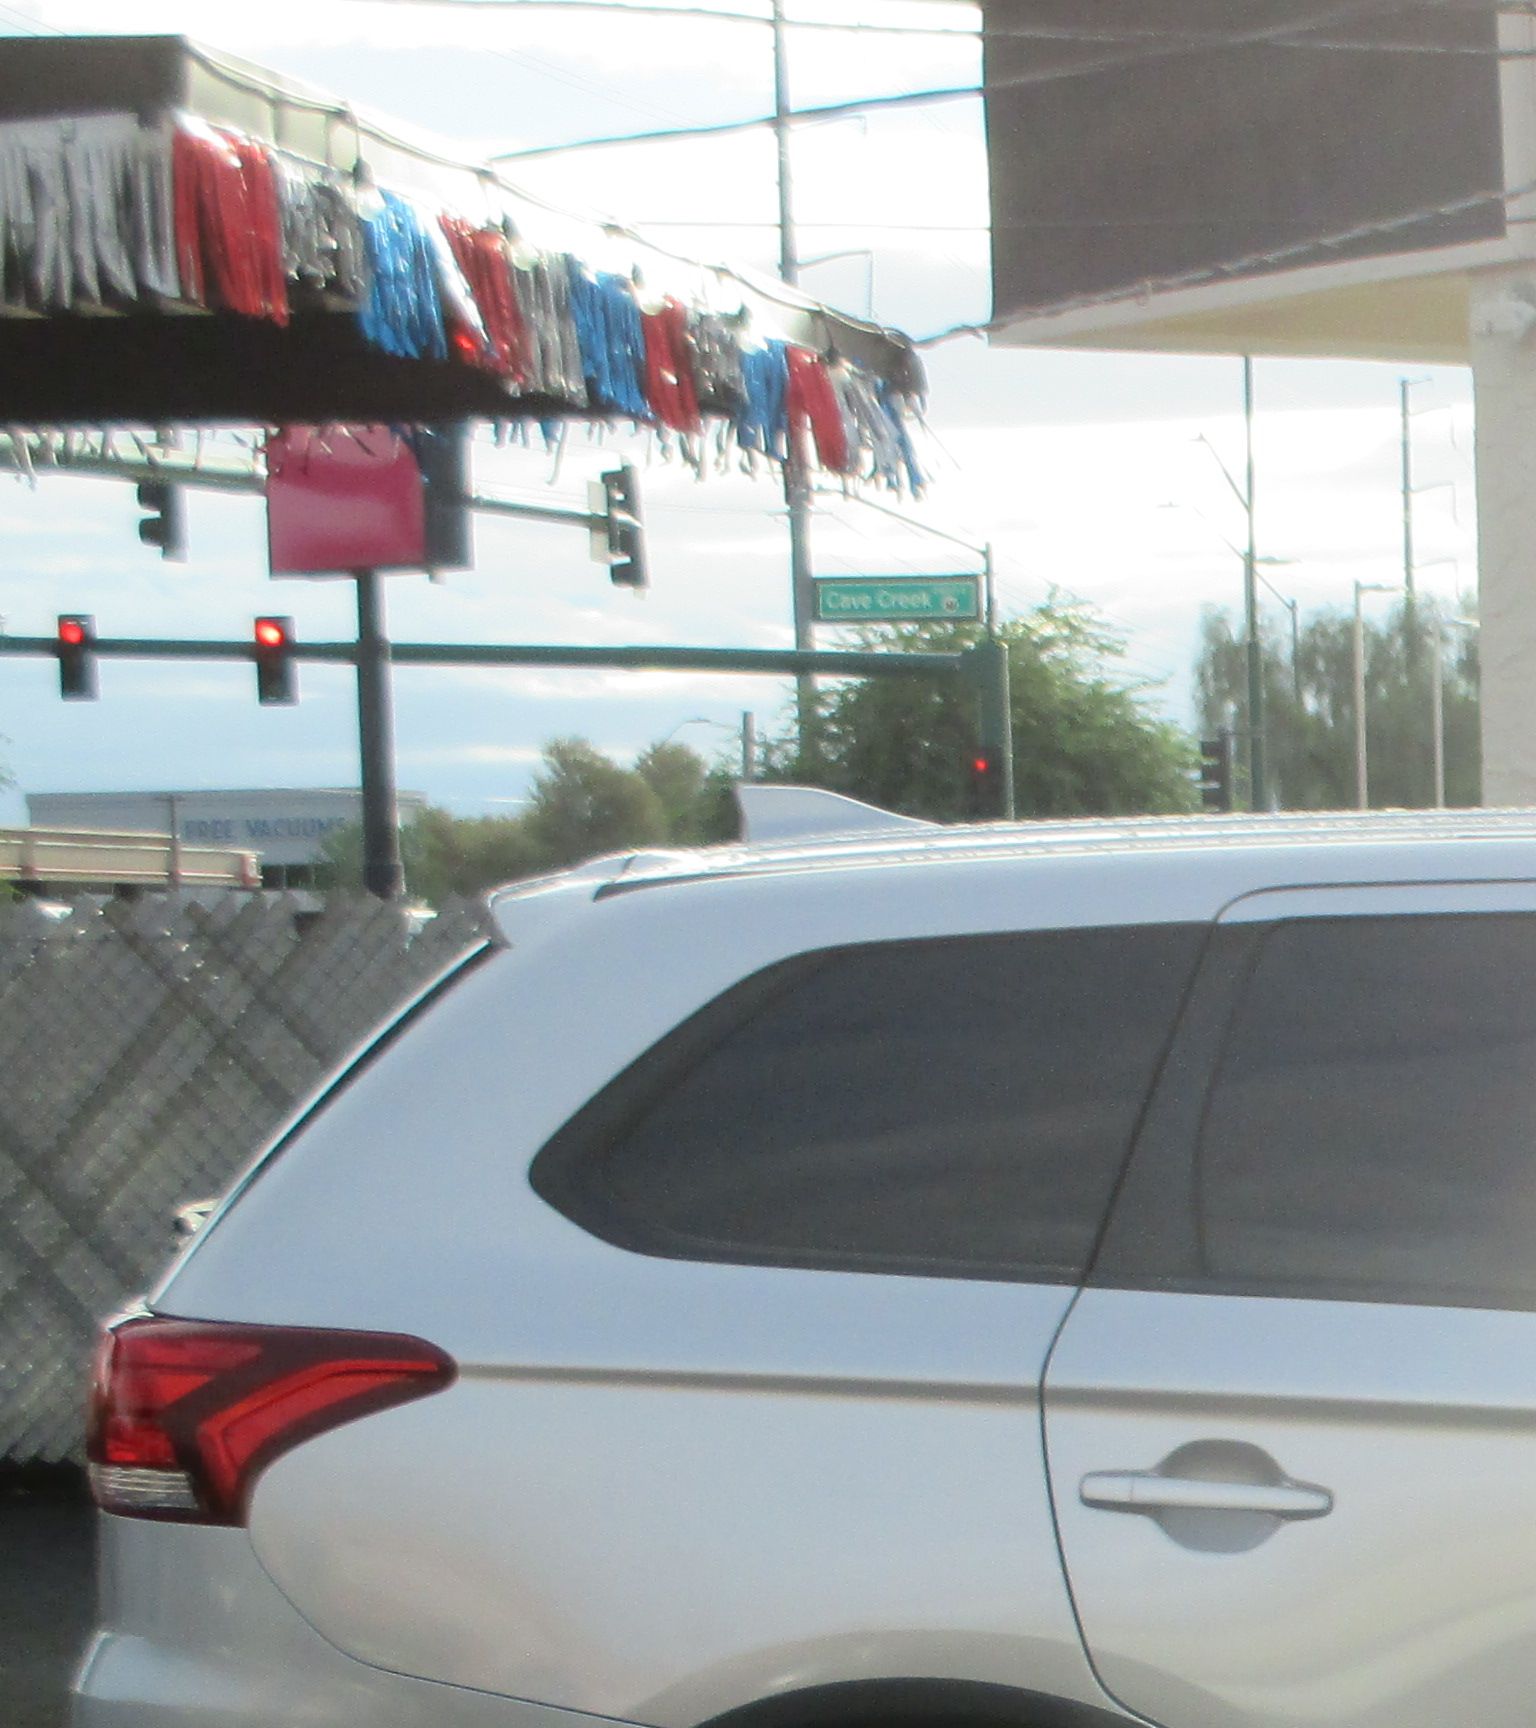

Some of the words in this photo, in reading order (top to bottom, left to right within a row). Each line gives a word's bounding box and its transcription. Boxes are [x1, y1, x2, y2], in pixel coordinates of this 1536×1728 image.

[827, 592, 872, 609] Cave
[877, 590, 932, 609] Creek
[184, 819, 232, 839] FREE
